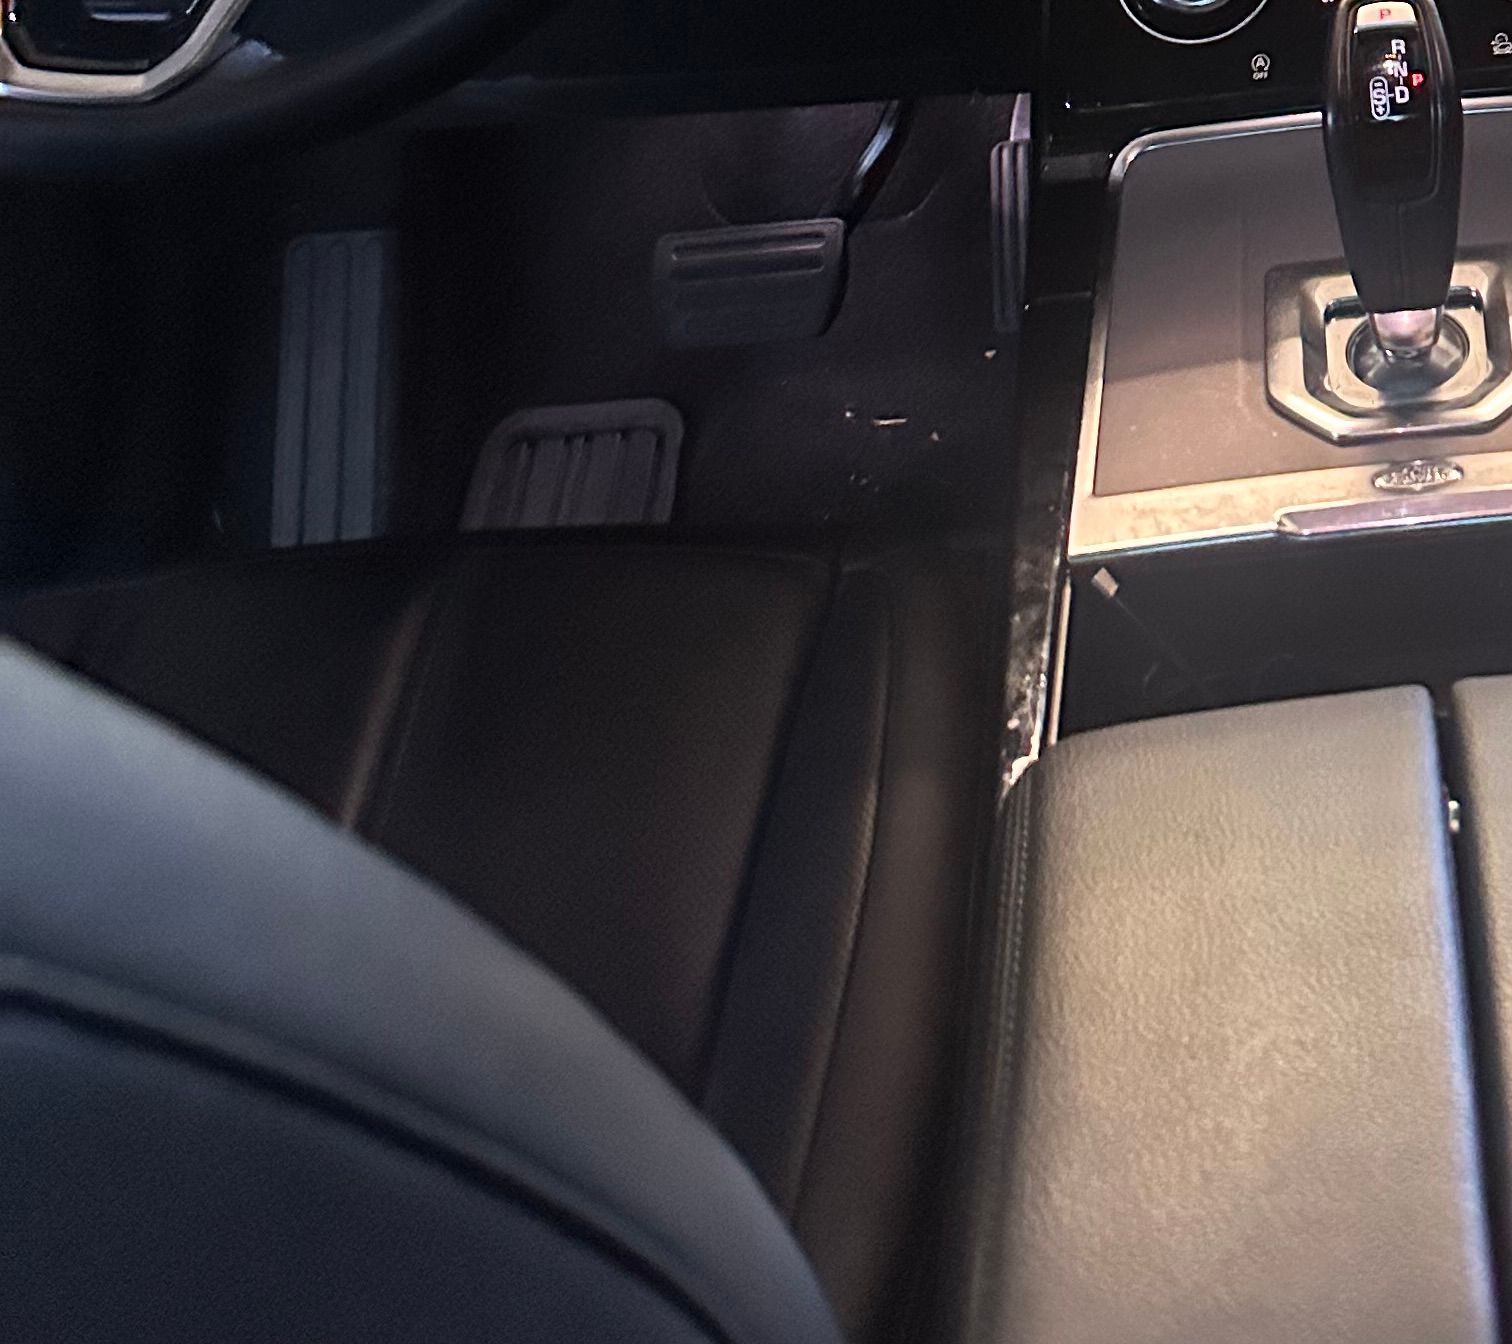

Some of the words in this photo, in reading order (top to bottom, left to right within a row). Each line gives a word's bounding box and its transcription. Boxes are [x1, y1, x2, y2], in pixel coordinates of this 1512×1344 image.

[1379, 8, 1391, 20] P
[1391, 38, 1406, 55] R
[1393, 61, 1408, 78] N
[1411, 73, 1424, 87] P
[1373, 88, 1387, 105] S
[1394, 85, 1410, 104] D
